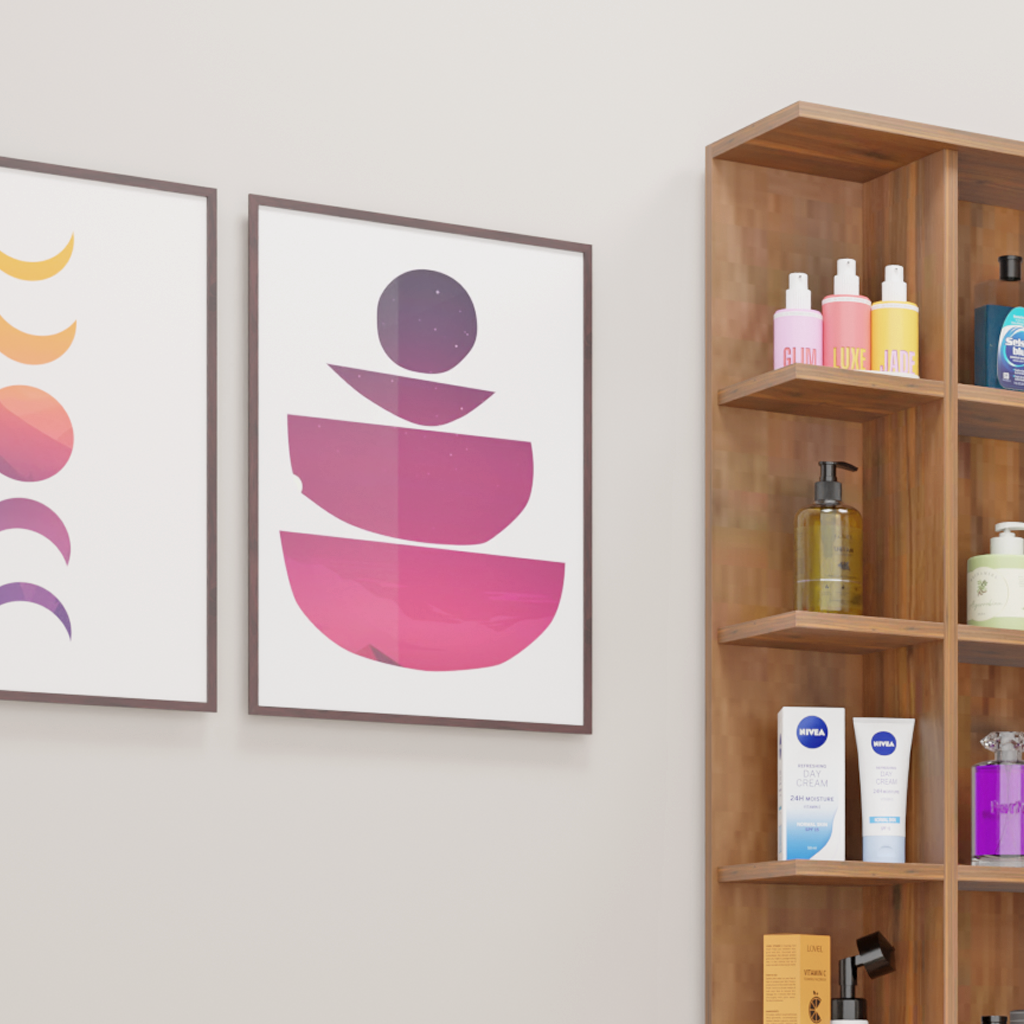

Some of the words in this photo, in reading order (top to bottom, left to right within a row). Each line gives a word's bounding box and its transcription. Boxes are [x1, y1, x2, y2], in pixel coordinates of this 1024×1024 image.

[833, 346, 866, 370] LUXE
[880, 349, 916, 375] JADE
[798, 728, 826, 737] NIVEA
[873, 740, 895, 748] NIVEA
[803, 769, 822, 778] DAY
[796, 778, 829, 787] CREAM
[875, 778, 898, 786] CREAM
